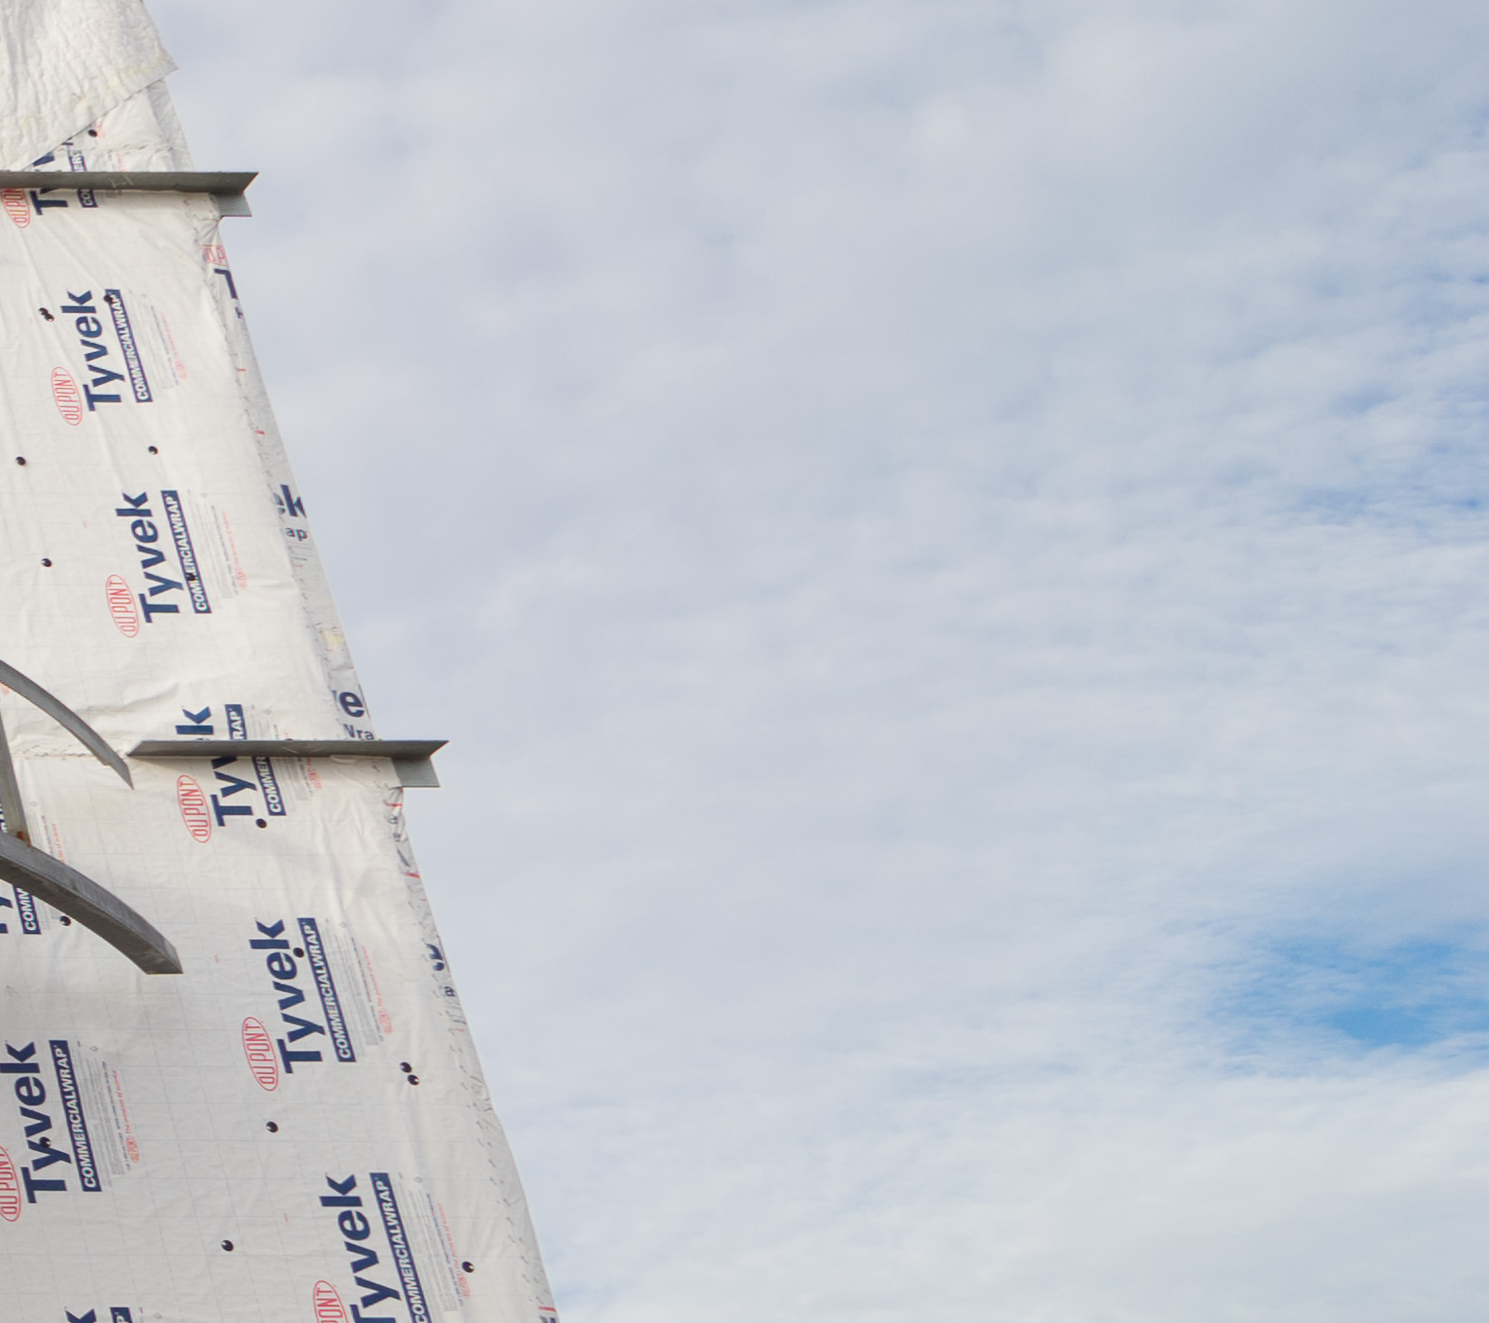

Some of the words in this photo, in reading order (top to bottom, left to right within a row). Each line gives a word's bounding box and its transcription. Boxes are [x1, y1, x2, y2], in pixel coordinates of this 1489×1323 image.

[60, 288, 125, 411] Tyvek
[115, 491, 184, 623] Tyvek
[249, 918, 326, 1074] Tyvek
[303, 922, 353, 1060] COMMERCIALWRAP
[53, 1046, 98, 1188] COMMERCIALWRAP
